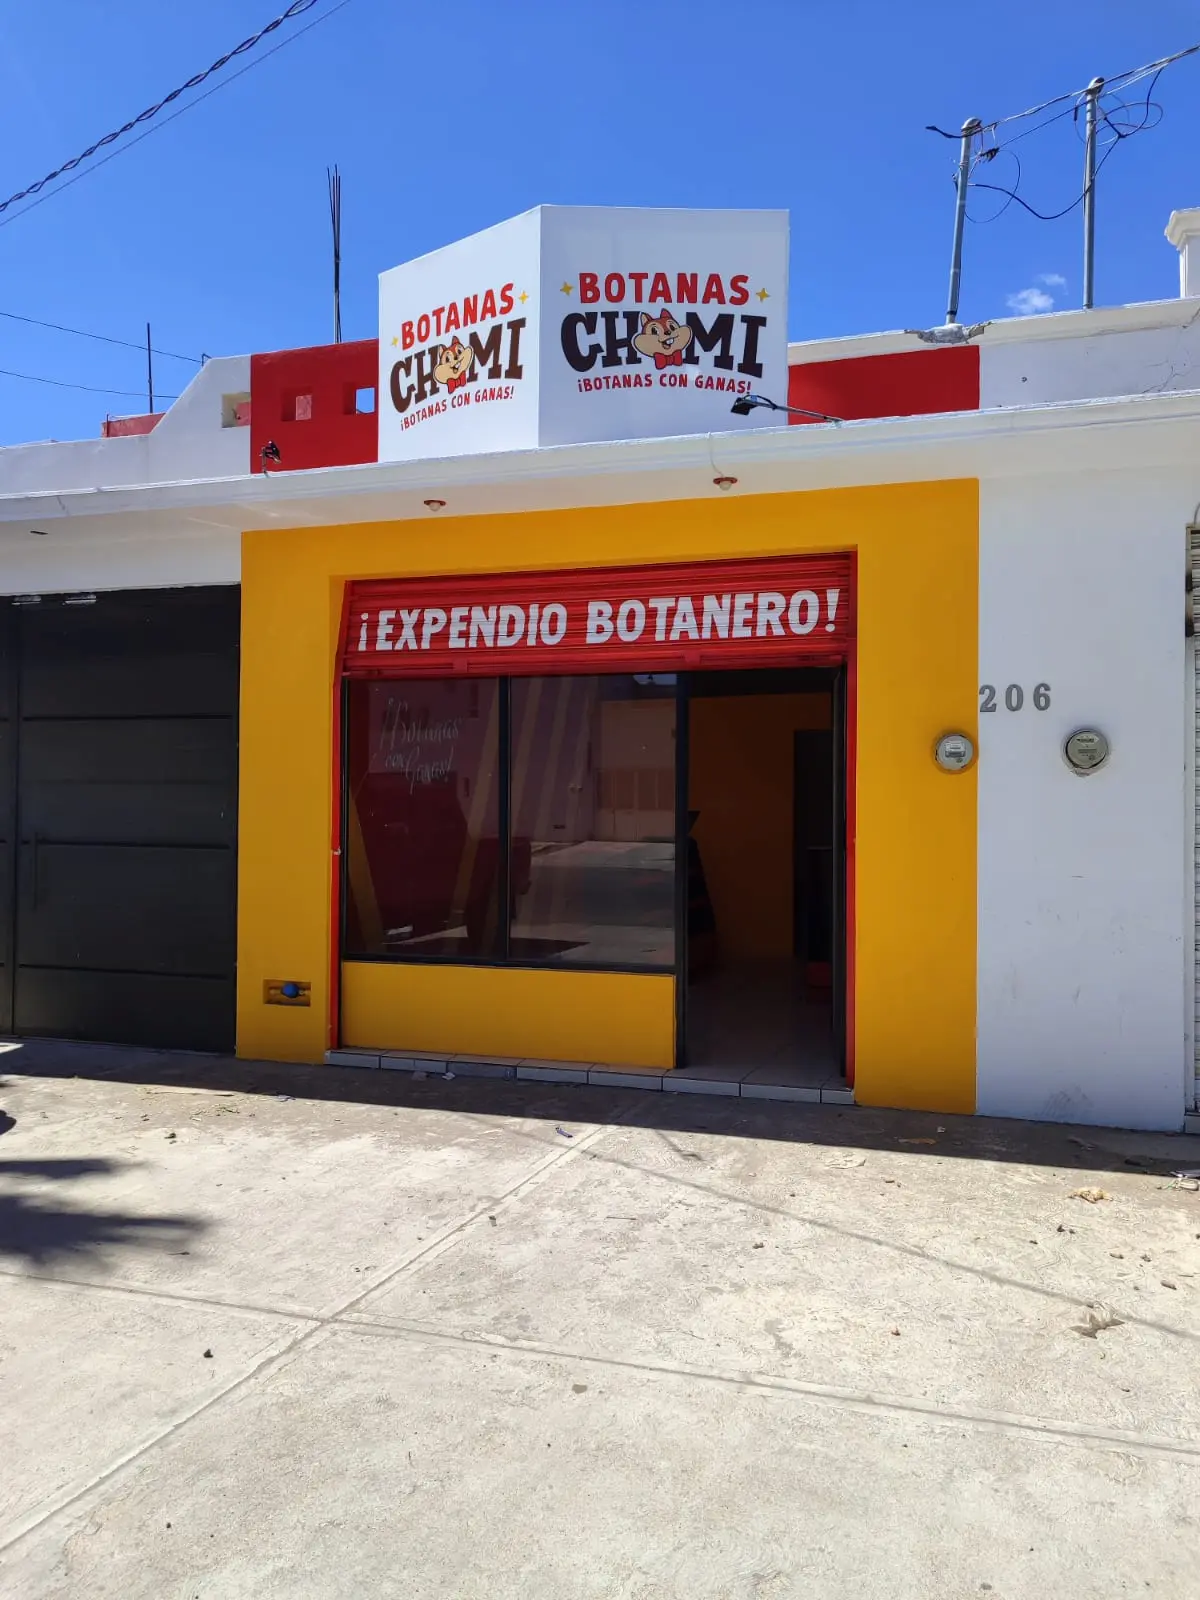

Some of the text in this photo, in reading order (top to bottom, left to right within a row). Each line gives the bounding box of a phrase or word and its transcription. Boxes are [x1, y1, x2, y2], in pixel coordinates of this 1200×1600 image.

[401, 282, 514, 351] BOTANAS
[579, 272, 750, 306] BOTANAS
[390, 317, 527, 414] CHMI
[561, 309, 767, 379] CHMI
[400, 385, 515, 432] ¡BOTANAS CON GANAS!
[578, 373, 752, 395] ¡BOTANAS CON GANAS!
[357, 588, 841, 652] ¡EXPENDIO BOTANERO!
[978, 682, 1051, 713] 206
